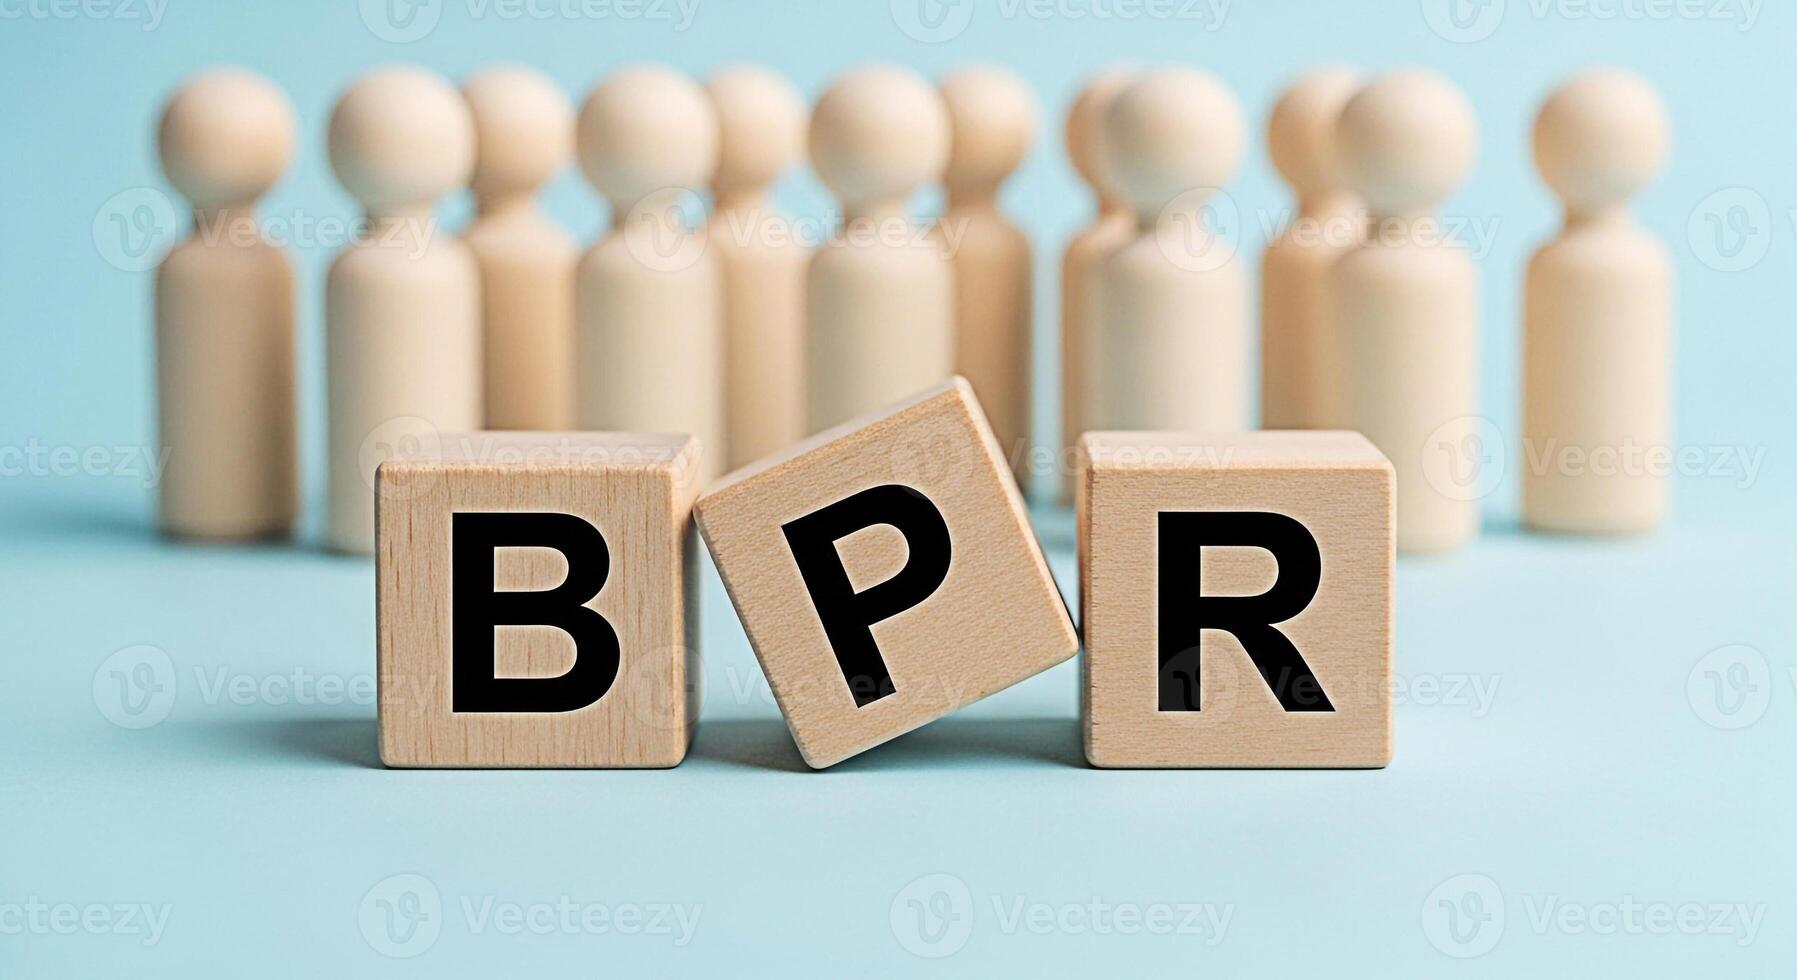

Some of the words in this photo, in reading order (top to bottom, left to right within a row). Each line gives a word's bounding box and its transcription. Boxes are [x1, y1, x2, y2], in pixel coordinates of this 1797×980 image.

[452, 512, 621, 713] B
[780, 484, 952, 708] P
[1157, 511, 1336, 712] R
